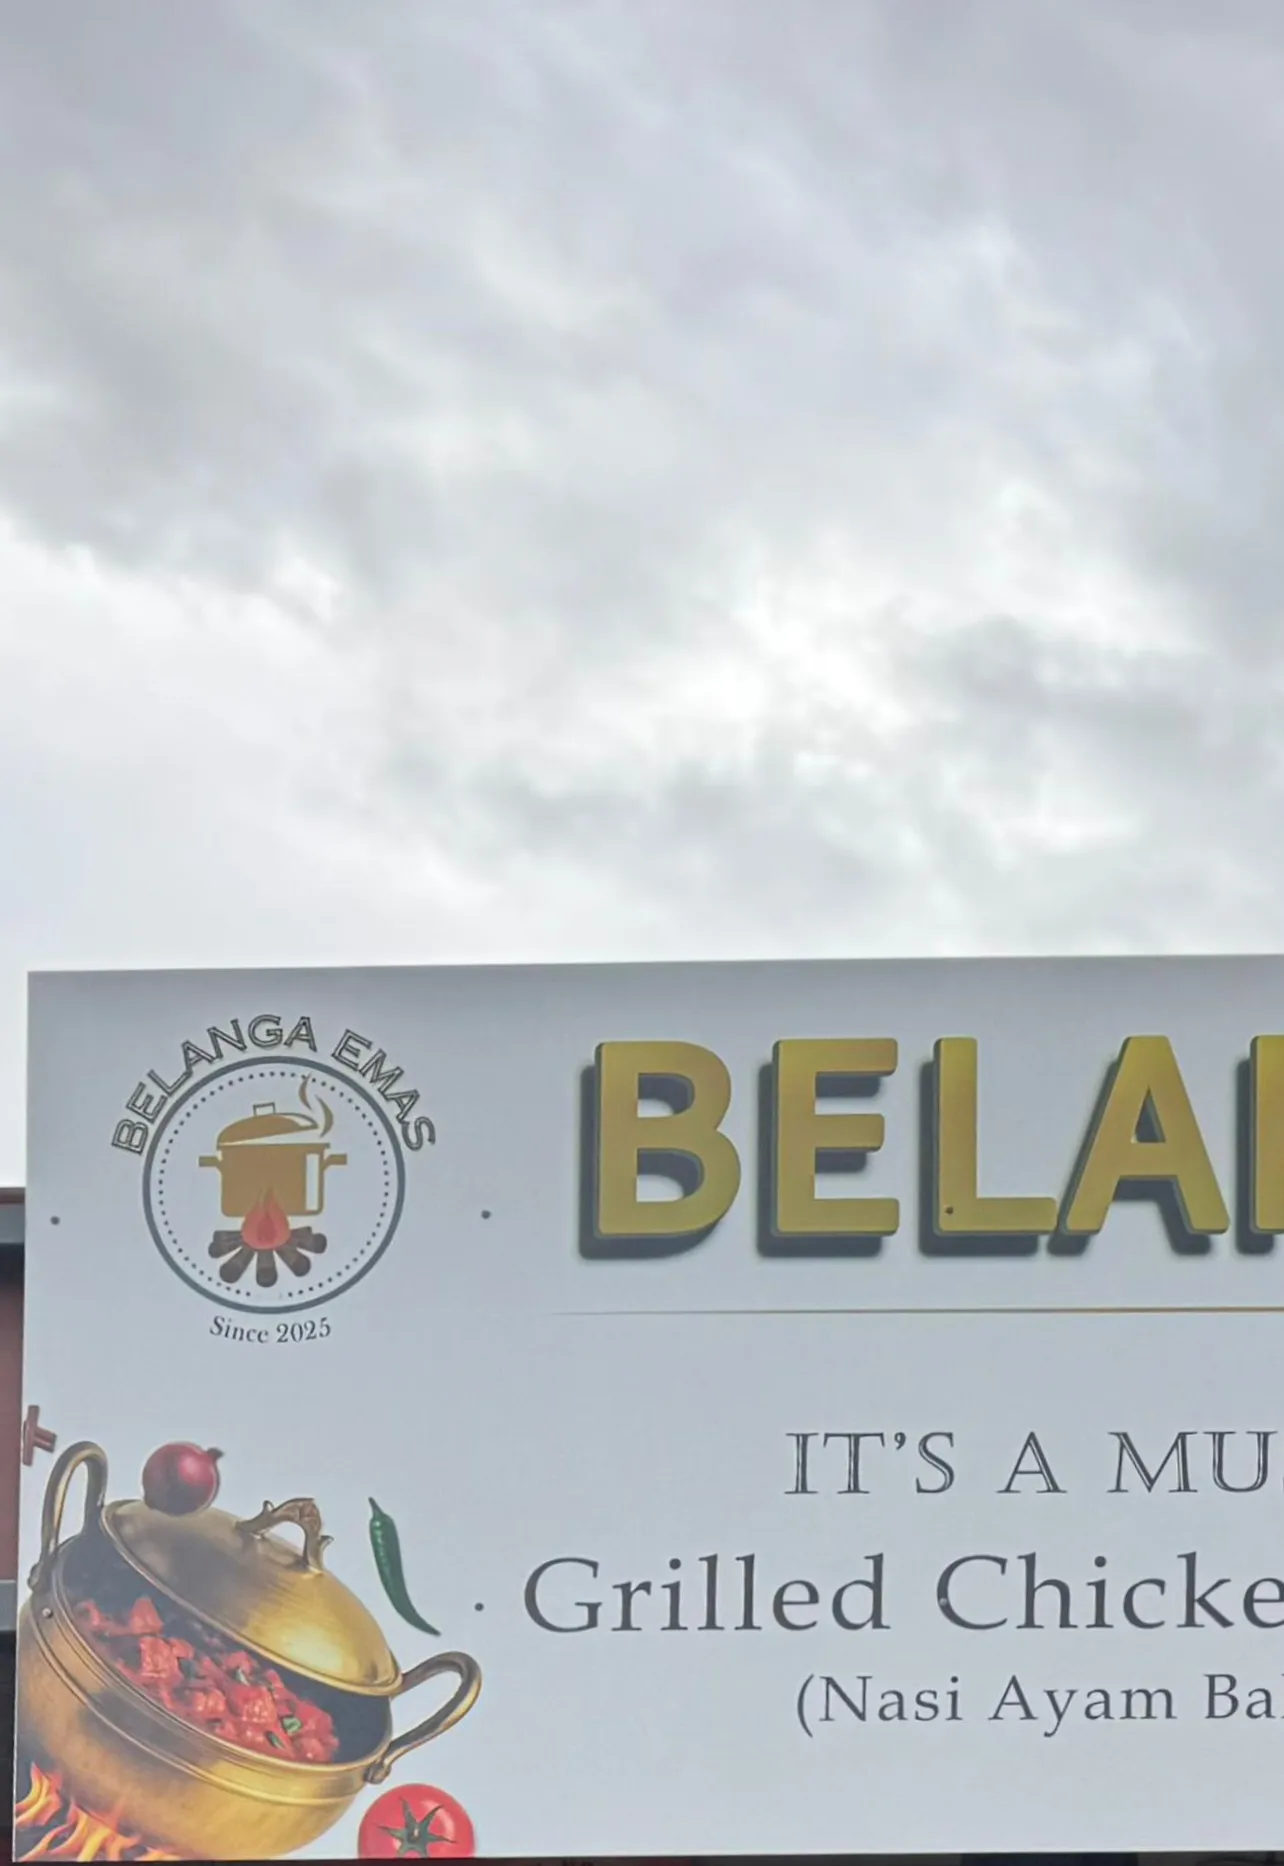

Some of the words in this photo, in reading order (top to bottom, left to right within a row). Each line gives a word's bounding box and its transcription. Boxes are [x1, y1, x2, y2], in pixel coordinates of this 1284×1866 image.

[112, 1014, 318, 1157] BELANGA
[331, 1028, 437, 1152] EMAS
[209, 1315, 269, 1345] Since
[276, 1316, 332, 1344] 2025
[783, 1430, 957, 1497] IT'S
[997, 1431, 1067, 1495] A
[522, 1554, 890, 1634] Grilled
[795, 1672, 963, 1738] (Nasi
[988, 1674, 1176, 1739] Ayam
